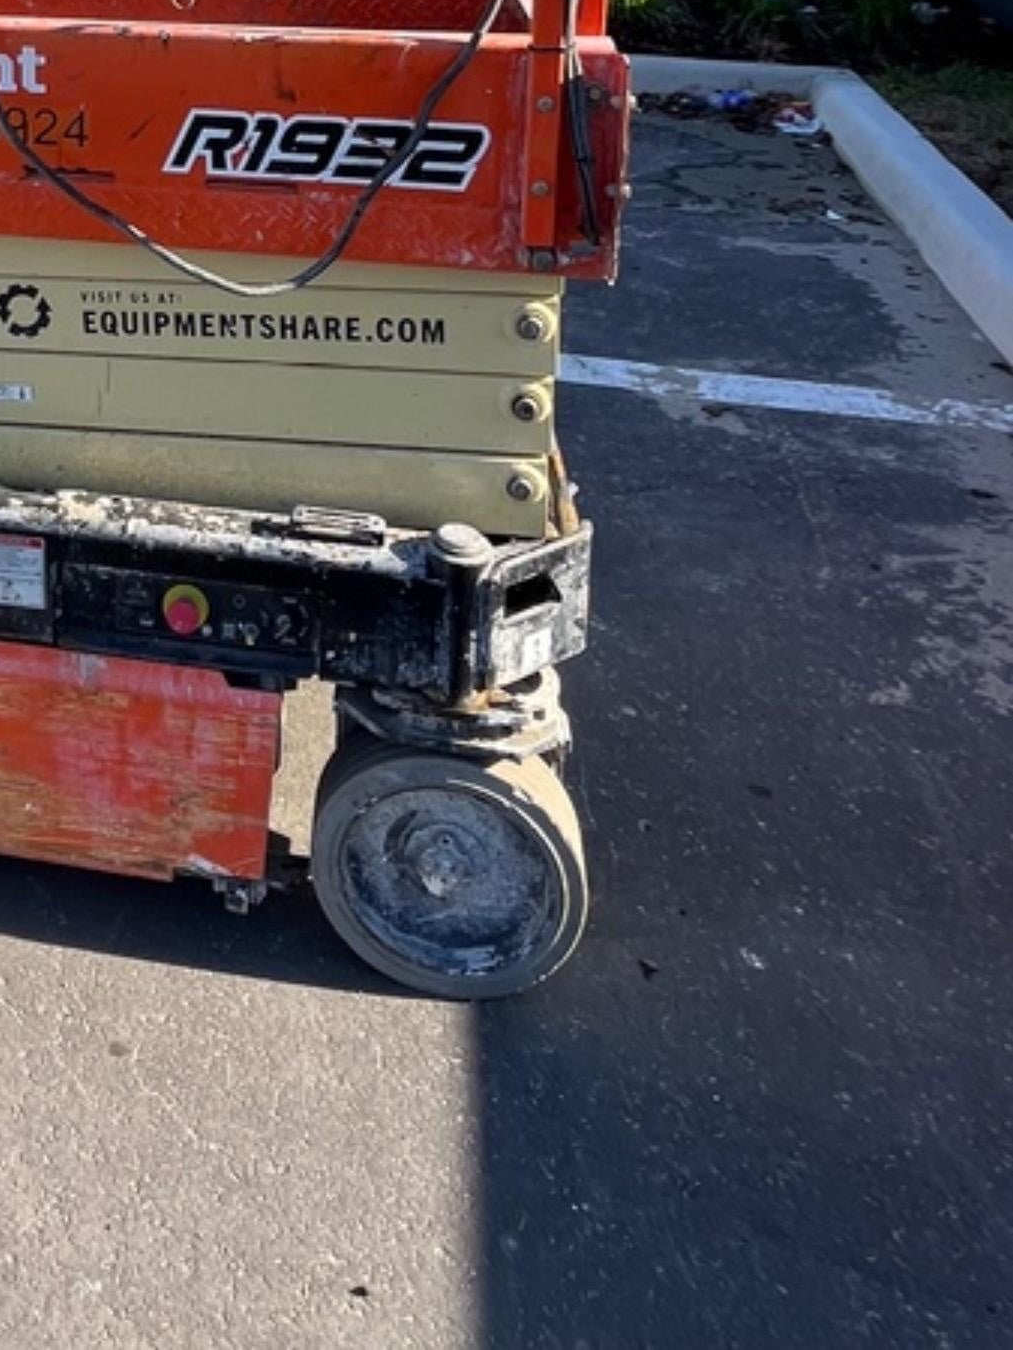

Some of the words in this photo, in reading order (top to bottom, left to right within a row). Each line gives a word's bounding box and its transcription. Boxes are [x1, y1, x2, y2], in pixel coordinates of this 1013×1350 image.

[162, 106, 491, 192] R1932
[80, 290, 122, 303] VISIT
[130, 291, 151, 304] US
[82, 310, 447, 345] EQUIPMENTSHARE.COM
